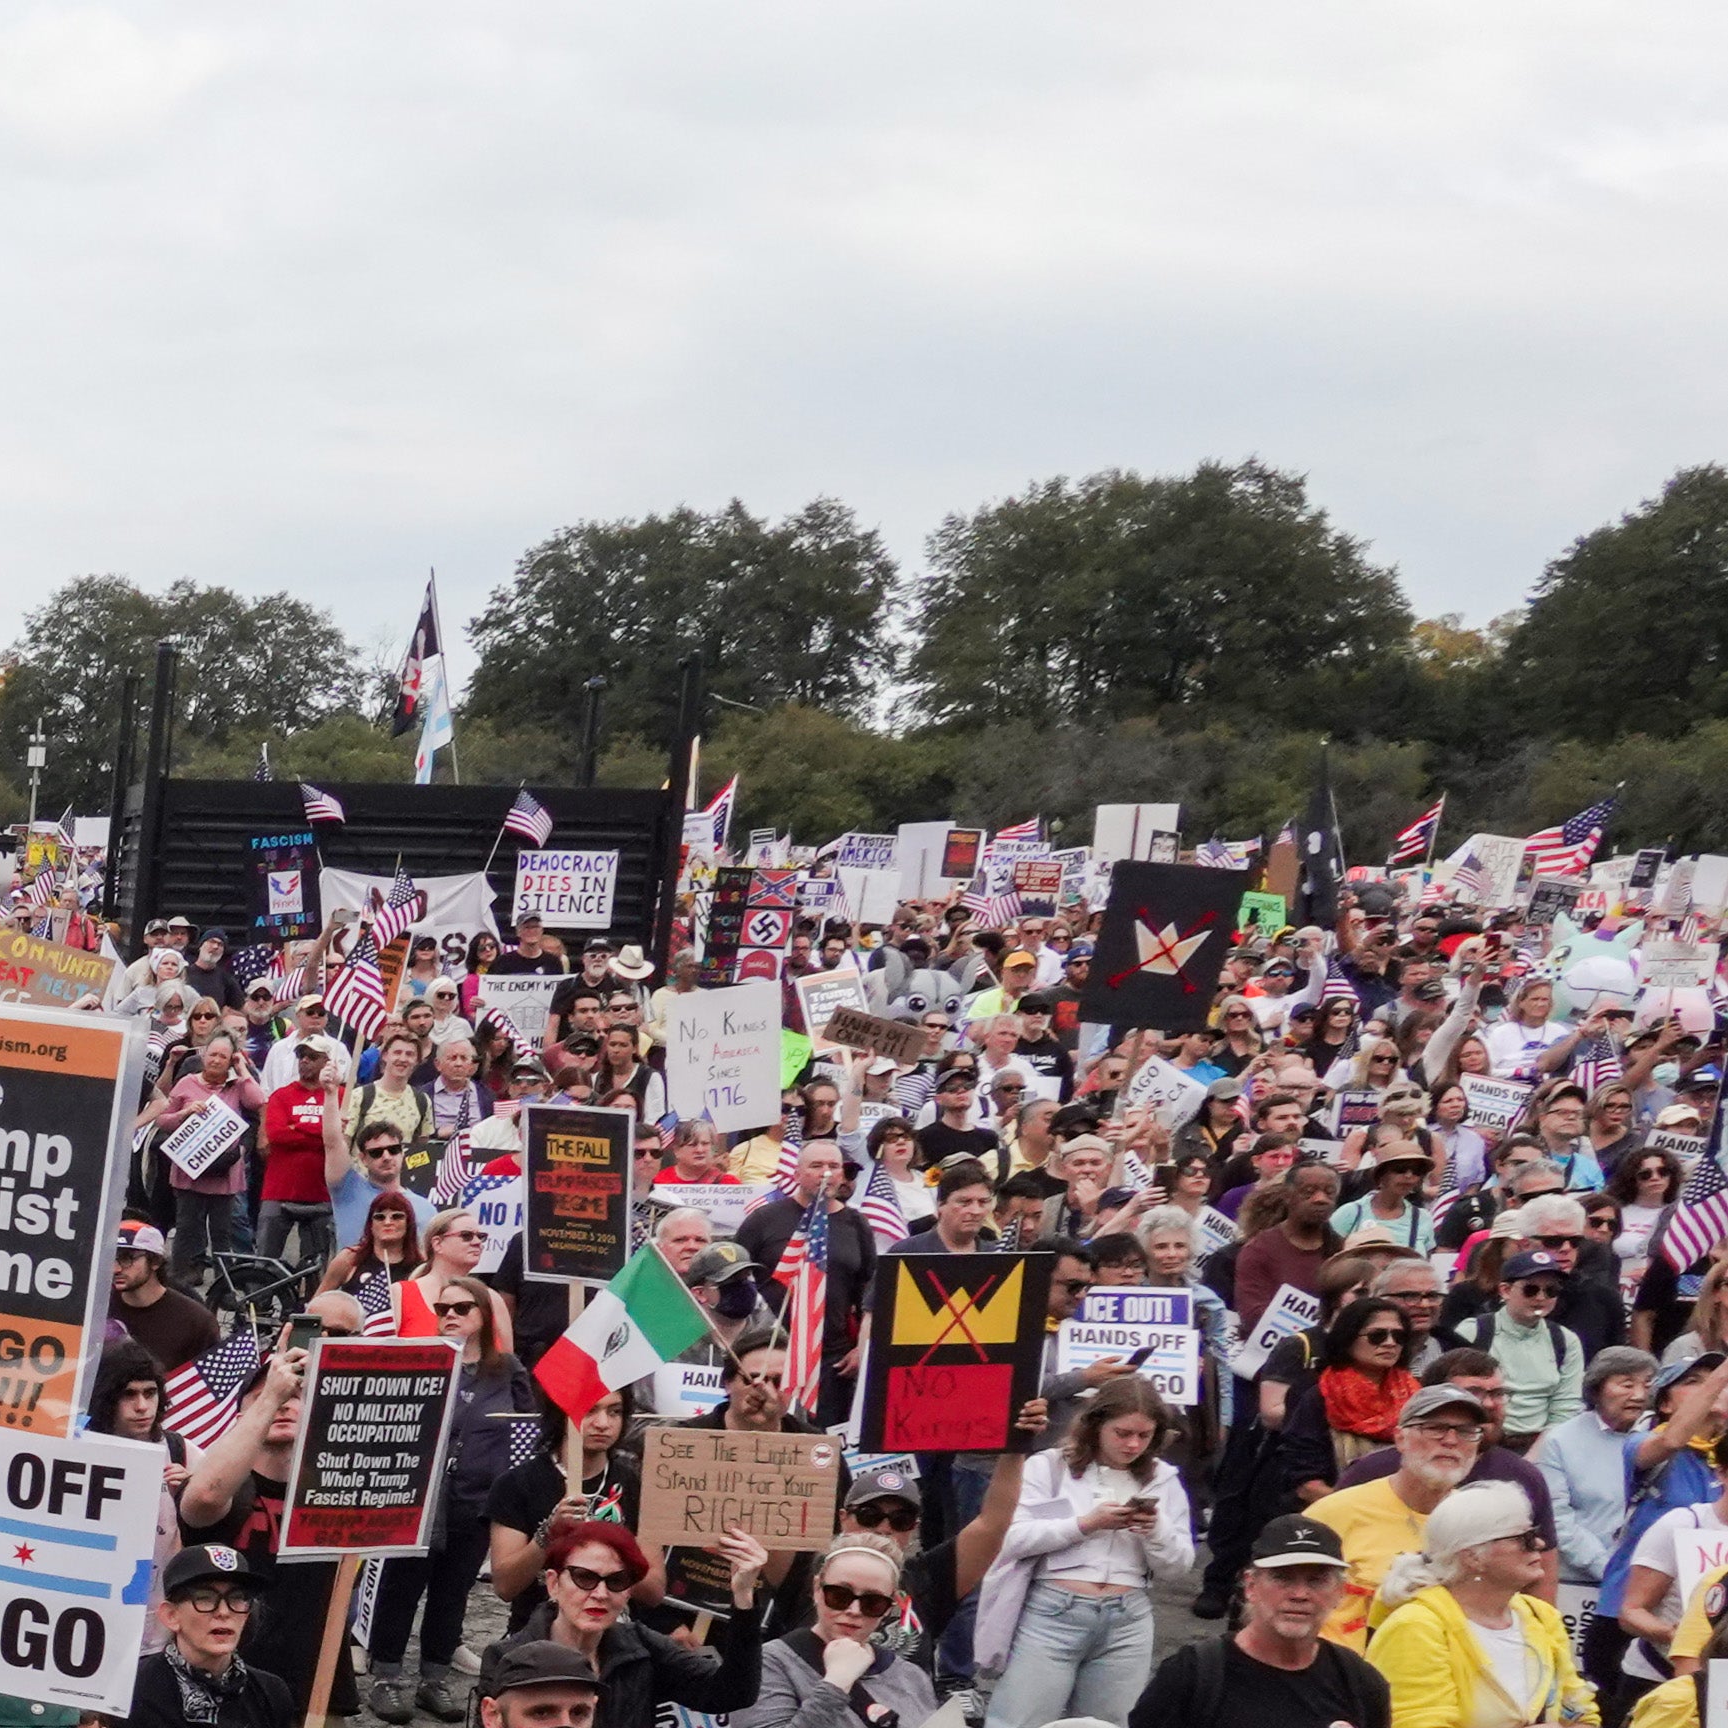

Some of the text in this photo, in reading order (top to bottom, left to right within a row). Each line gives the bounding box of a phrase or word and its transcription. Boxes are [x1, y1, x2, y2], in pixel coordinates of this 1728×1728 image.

[518, 851, 617, 873] DEMOCRACY
[522, 875, 572, 894] DIES
[517, 893, 607, 915] SILENCE
[1123, 1296, 1173, 1323] OUT!
[1069, 1327, 1187, 1350] HANDS OFF
[320, 1376, 446, 1396] SHUT DOWN ICE!
[332, 1403, 424, 1422] NO MILITARY
[327, 1424, 422, 1443] OCCUPATION!
[316, 1451, 420, 1469] Shut Down The
[6, 1450, 126, 1521] OFF
[320, 1471, 409, 1489] Whole Trump
[304, 1488, 417, 1509] Fascist Regime!
